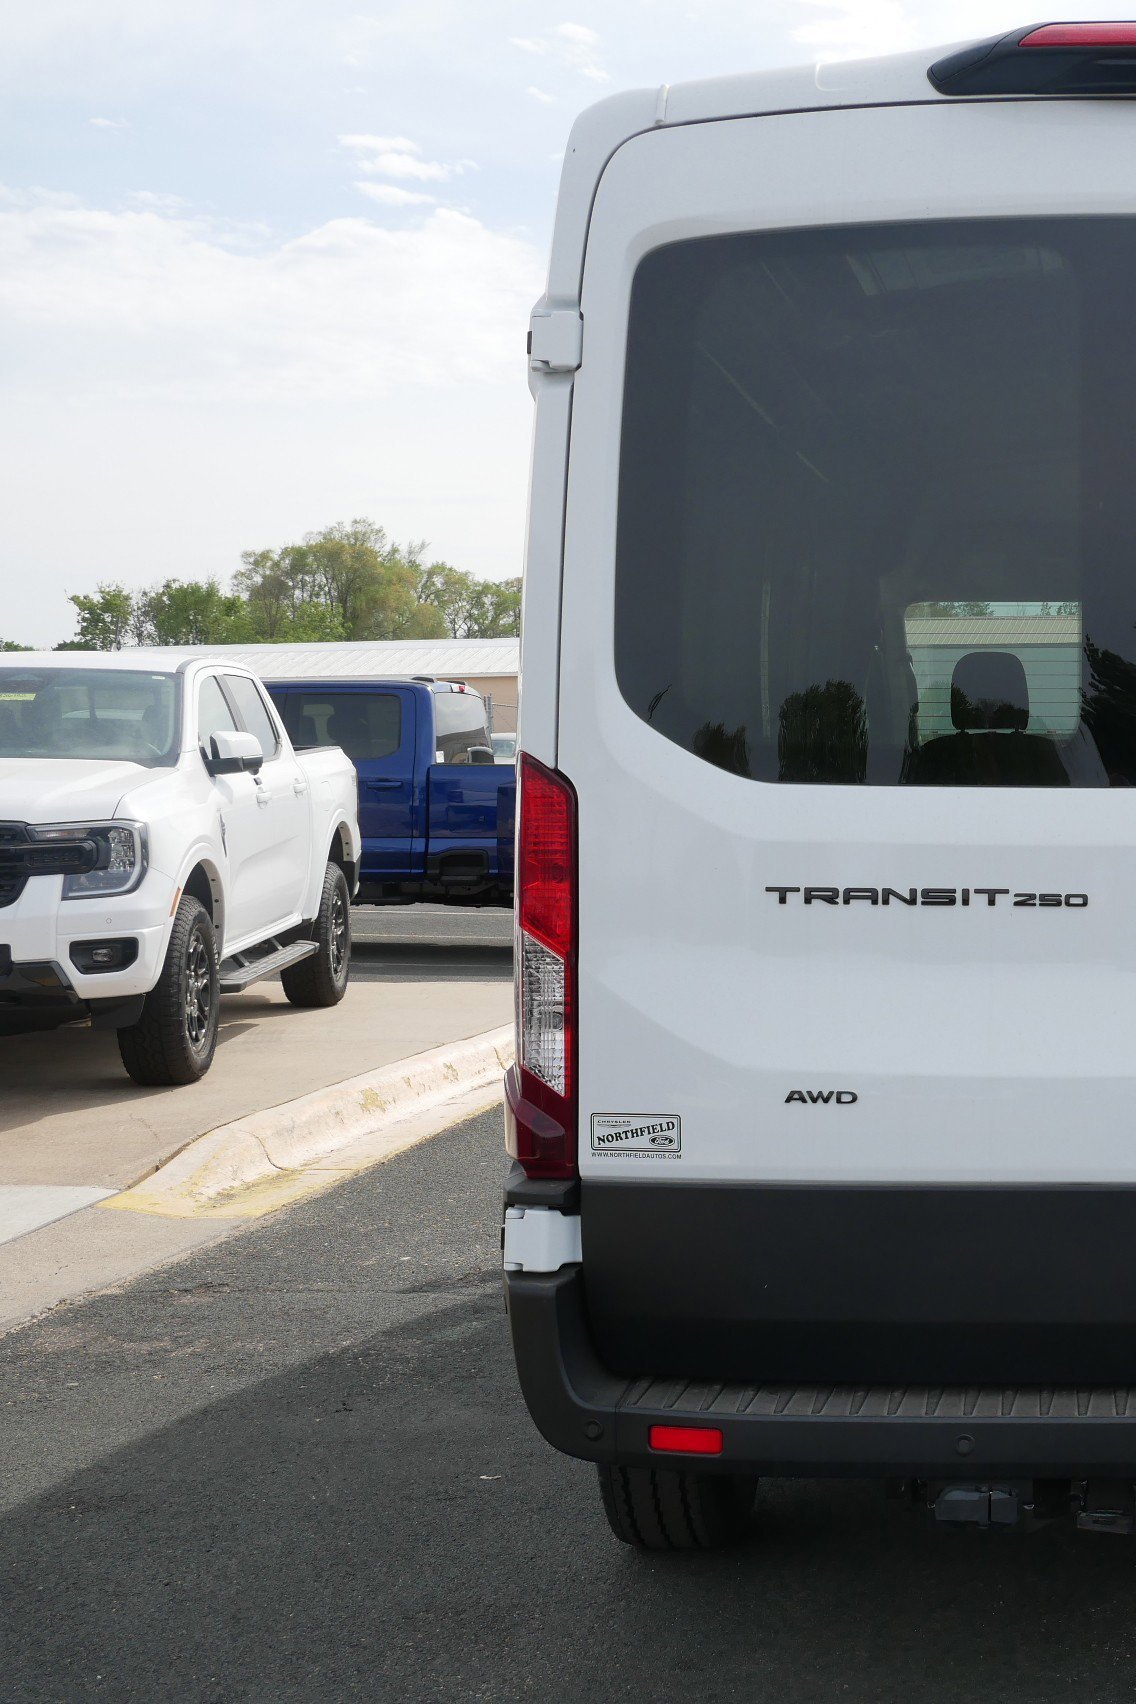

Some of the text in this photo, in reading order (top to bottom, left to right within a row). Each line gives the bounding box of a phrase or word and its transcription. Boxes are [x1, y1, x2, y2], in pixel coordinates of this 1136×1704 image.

[765, 886, 1089, 907] TRANSIT 250
[784, 1090, 858, 1104] AWD
[596, 1120, 676, 1146] NORTHFIELD
